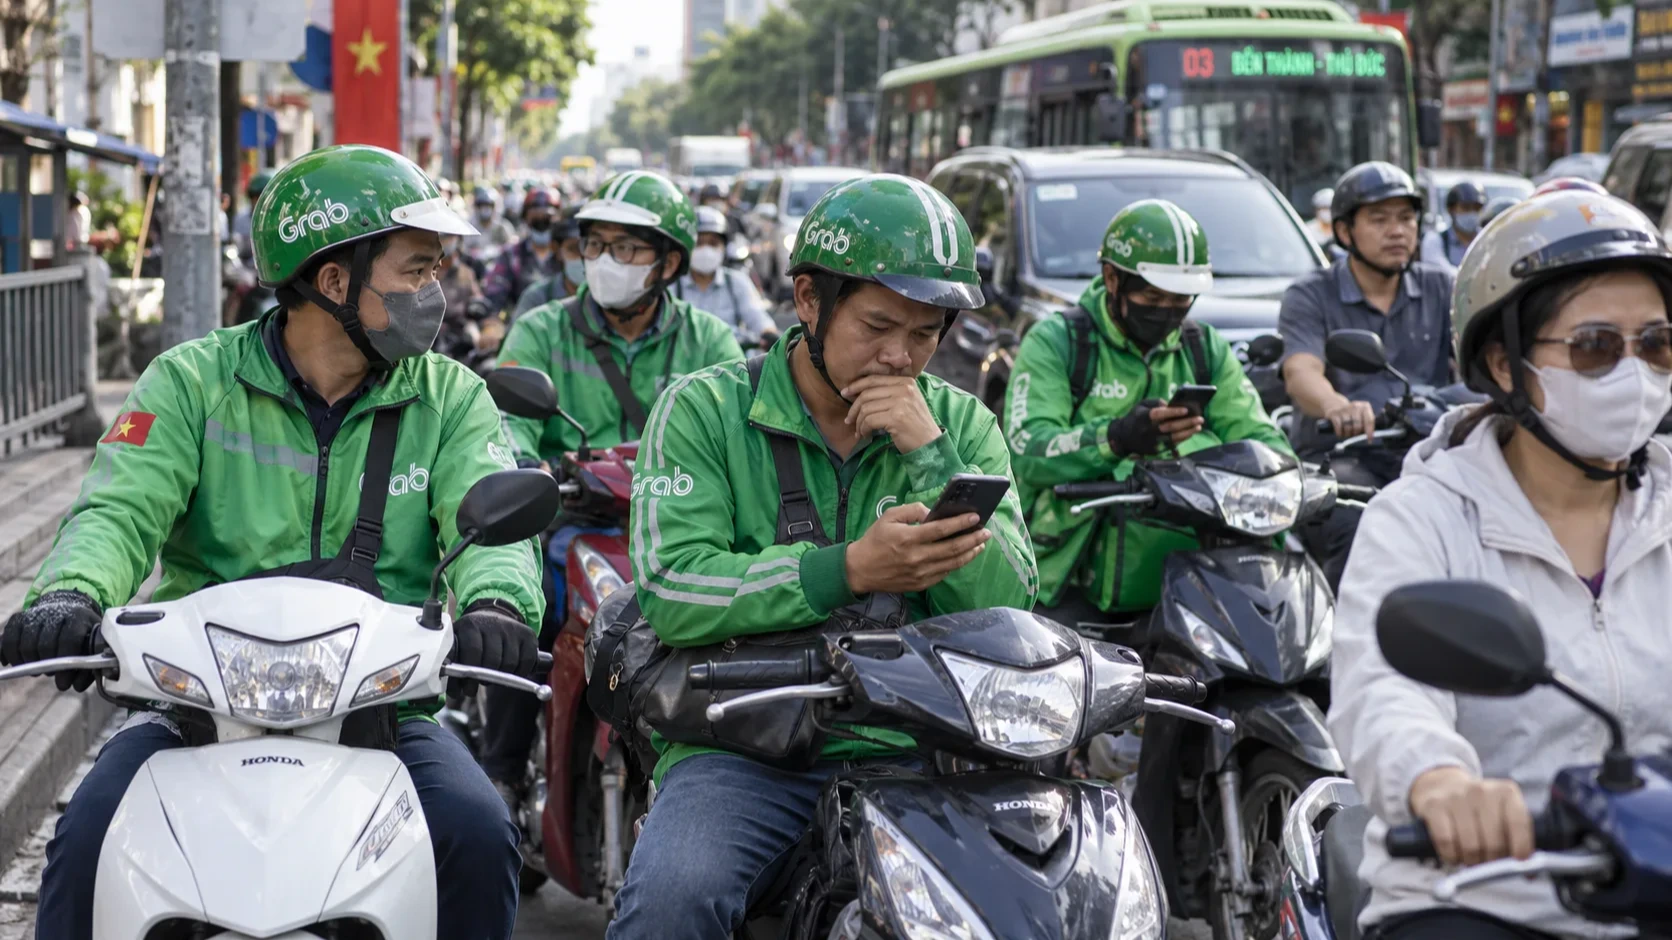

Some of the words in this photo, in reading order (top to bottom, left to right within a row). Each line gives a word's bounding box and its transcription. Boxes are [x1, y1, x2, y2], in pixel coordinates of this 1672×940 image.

[1183, 47, 1215, 78] 03
[278, 197, 349, 243] Grab
[805, 220, 850, 255] Grab
[241, 755, 305, 768] HONDA
[993, 800, 1060, 813] HONDA
